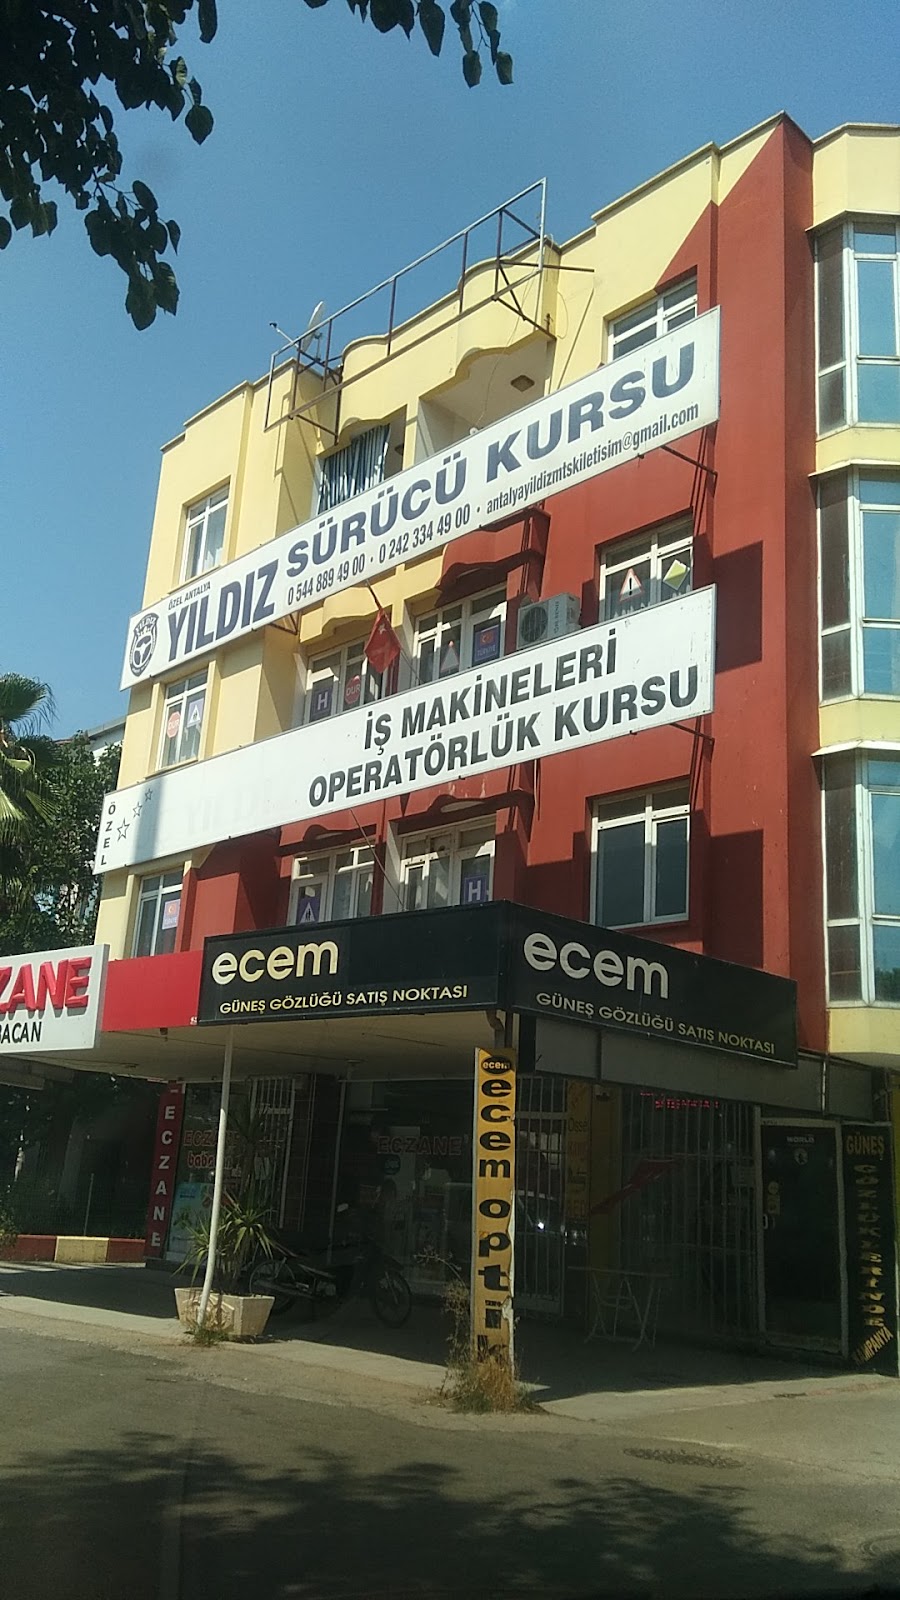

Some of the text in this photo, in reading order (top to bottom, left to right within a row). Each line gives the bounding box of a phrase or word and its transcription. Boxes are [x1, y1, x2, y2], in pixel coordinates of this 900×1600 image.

[286, 341, 695, 578] SÜRÜCÜ KURSU
[288, 401, 699, 605] 0 544 889 49 00 0 242 334 49 00 antalyayildizmtskiletisim@gmail.com
[167, 558, 279, 662] YILDIZ
[168, 581, 211, 611] ÖZEL ANTALYA
[317, 690, 329, 711] H
[346, 681, 360, 697] DUR
[364, 628, 617, 755] İŞ MAKİNELERİ
[308, 665, 699, 808] OPERATÖRLÜK KURSU
[100, 801, 116, 866] ÖZEL
[468, 879, 482, 902] H
[211, 940, 339, 985] ecem
[523, 932, 669, 999] ecem
[219, 985, 468, 1014] GÜNEŞ GÖZLÜĞÜ SATIŞ NOKTASI
[536, 992, 775, 1055] GÜNEŞ GÖZLÜĞÜ SATIŞ NOKTASI
[0, 1021, 42, 1044] ACAN
[376, 1135, 462, 1156] ECZANE
[479, 1079, 512, 1179] ecem
[846, 1132, 884, 1158] GÜNEŞ
[151, 1105, 176, 1247] ECZANE
